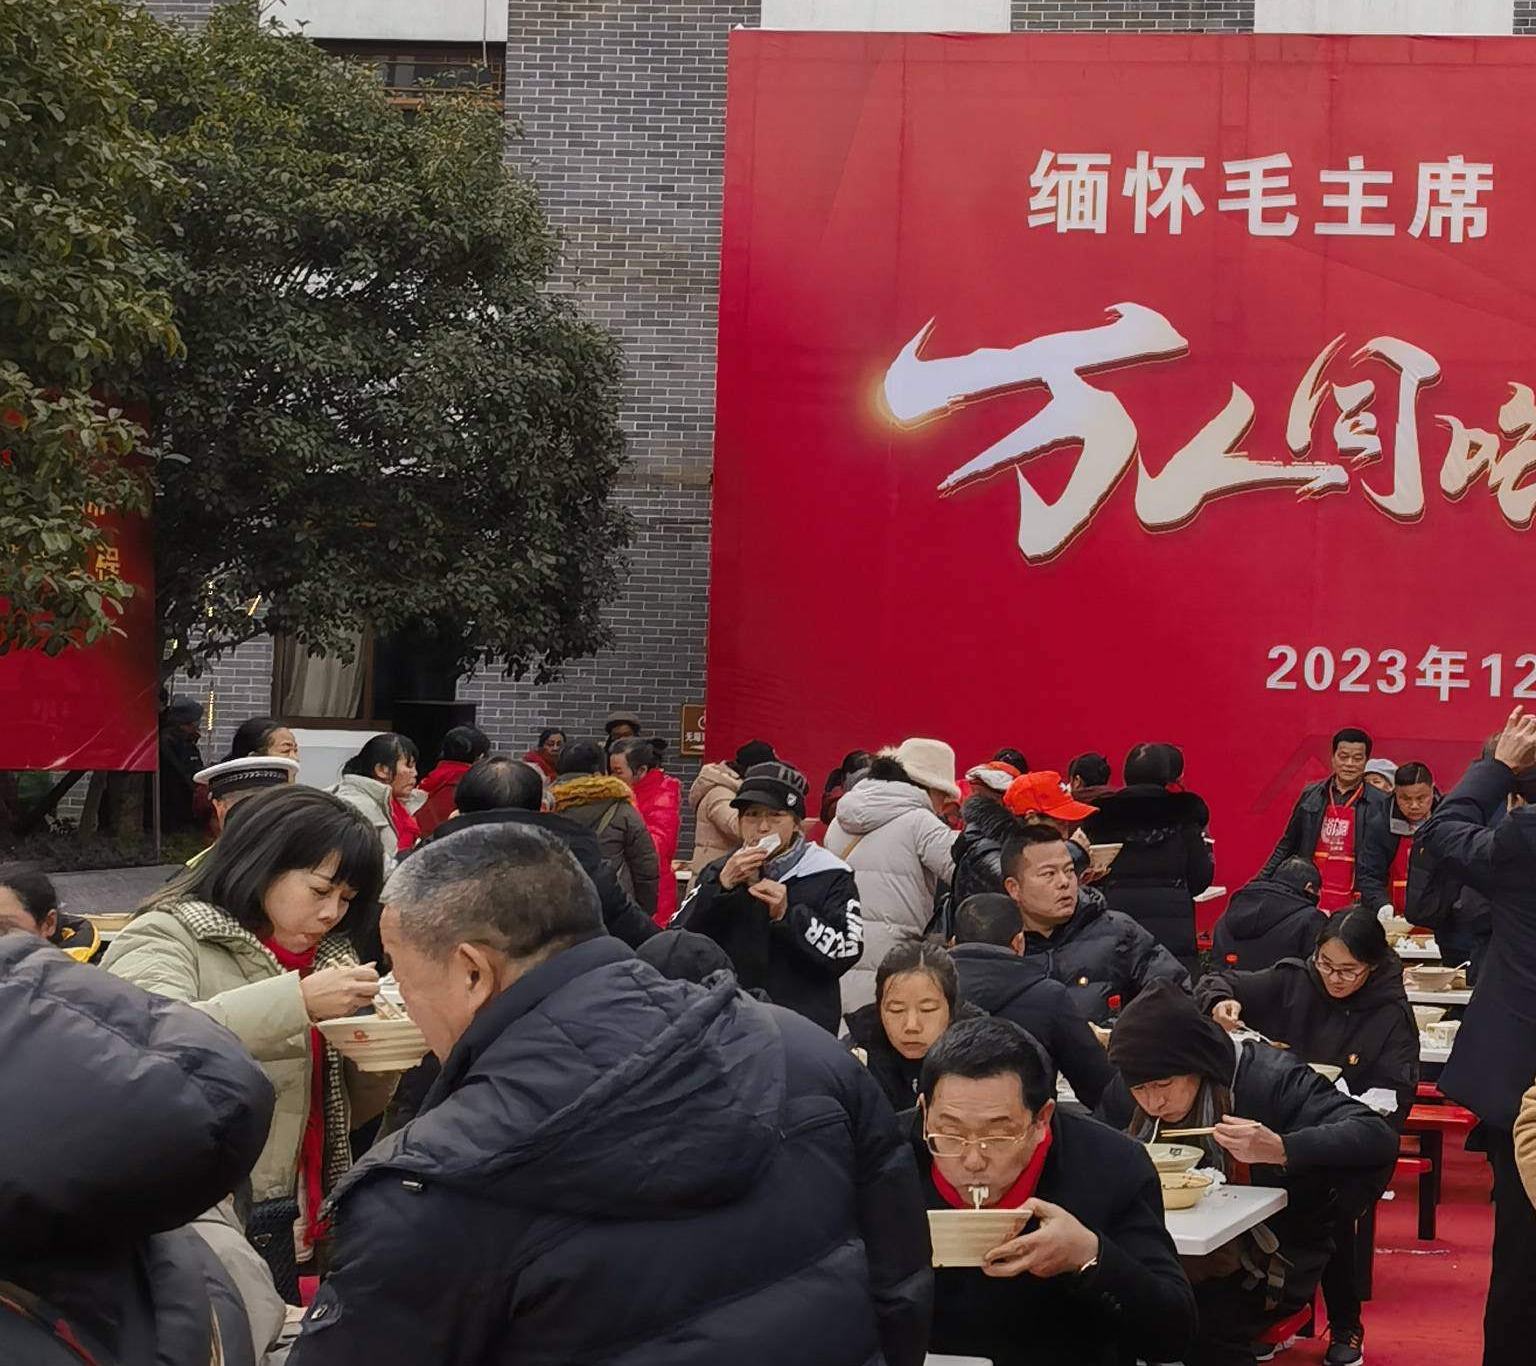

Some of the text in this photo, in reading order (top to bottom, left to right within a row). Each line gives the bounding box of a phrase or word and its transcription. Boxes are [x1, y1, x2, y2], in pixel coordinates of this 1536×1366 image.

[1027, 149, 1495, 243] 缅怀毛主席
